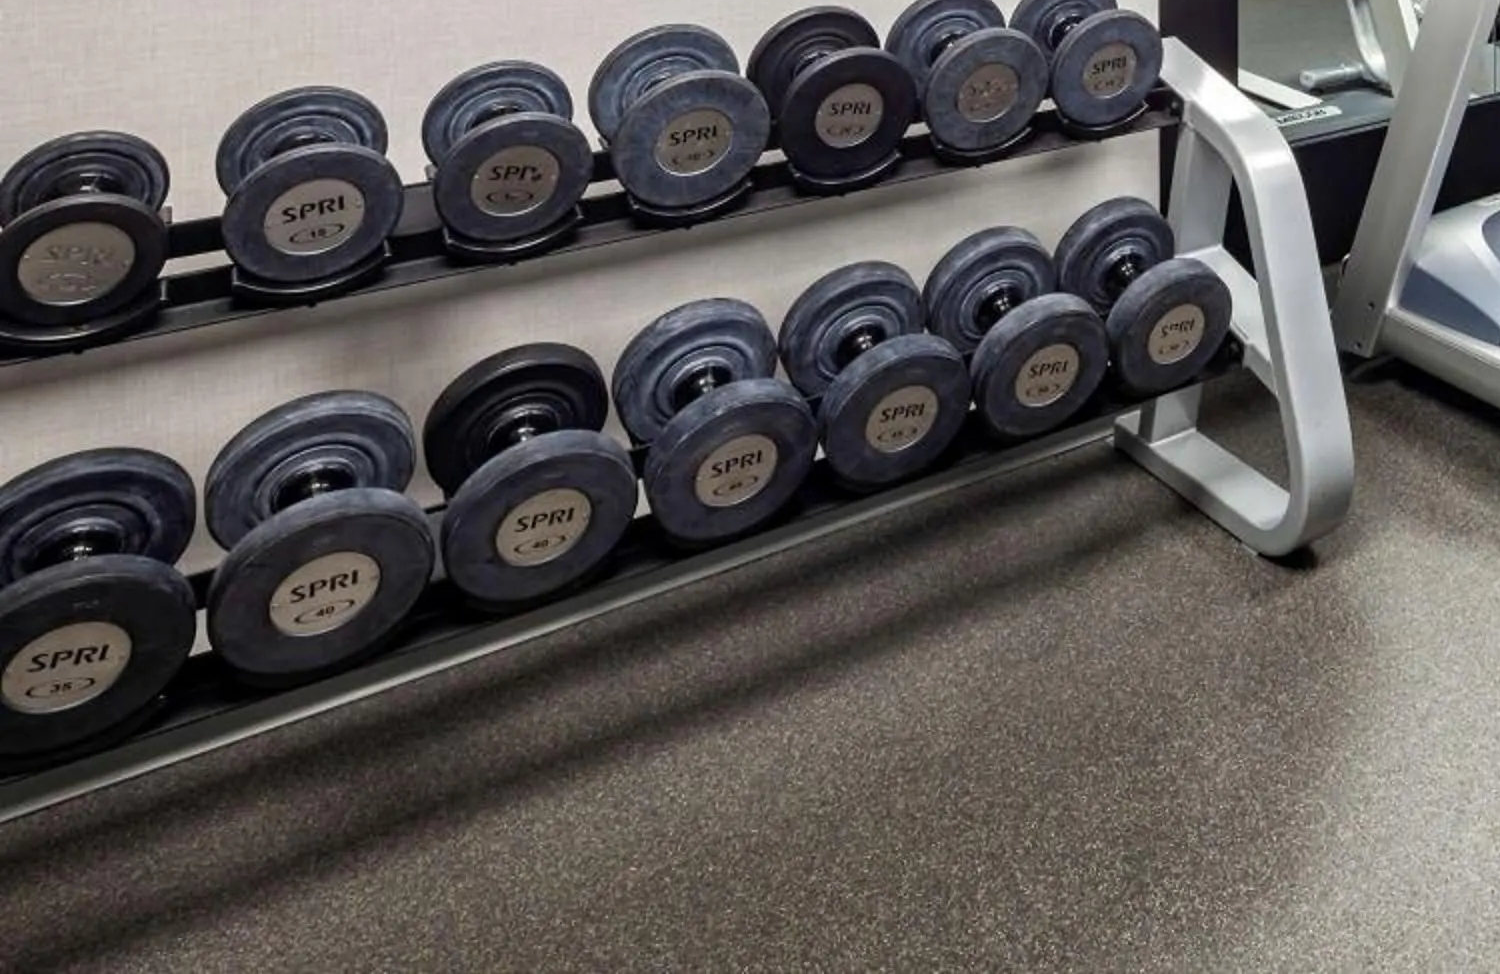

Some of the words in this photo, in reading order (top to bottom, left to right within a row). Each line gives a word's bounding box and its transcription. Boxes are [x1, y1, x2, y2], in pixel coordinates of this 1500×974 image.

[1091, 56, 1126, 75] SPRI
[829, 102, 871, 116] SPRI
[670, 125, 717, 146] SPRI
[282, 195, 345, 224] SPRI
[1161, 317, 1195, 338] SPRI
[1028, 360, 1068, 378] SPRI
[880, 403, 925, 423] SPRI
[710, 450, 761, 478] SPRI
[514, 508, 574, 532] SPRI
[290, 569, 358, 603] SPRI
[26, 644, 109, 672] SPRI
